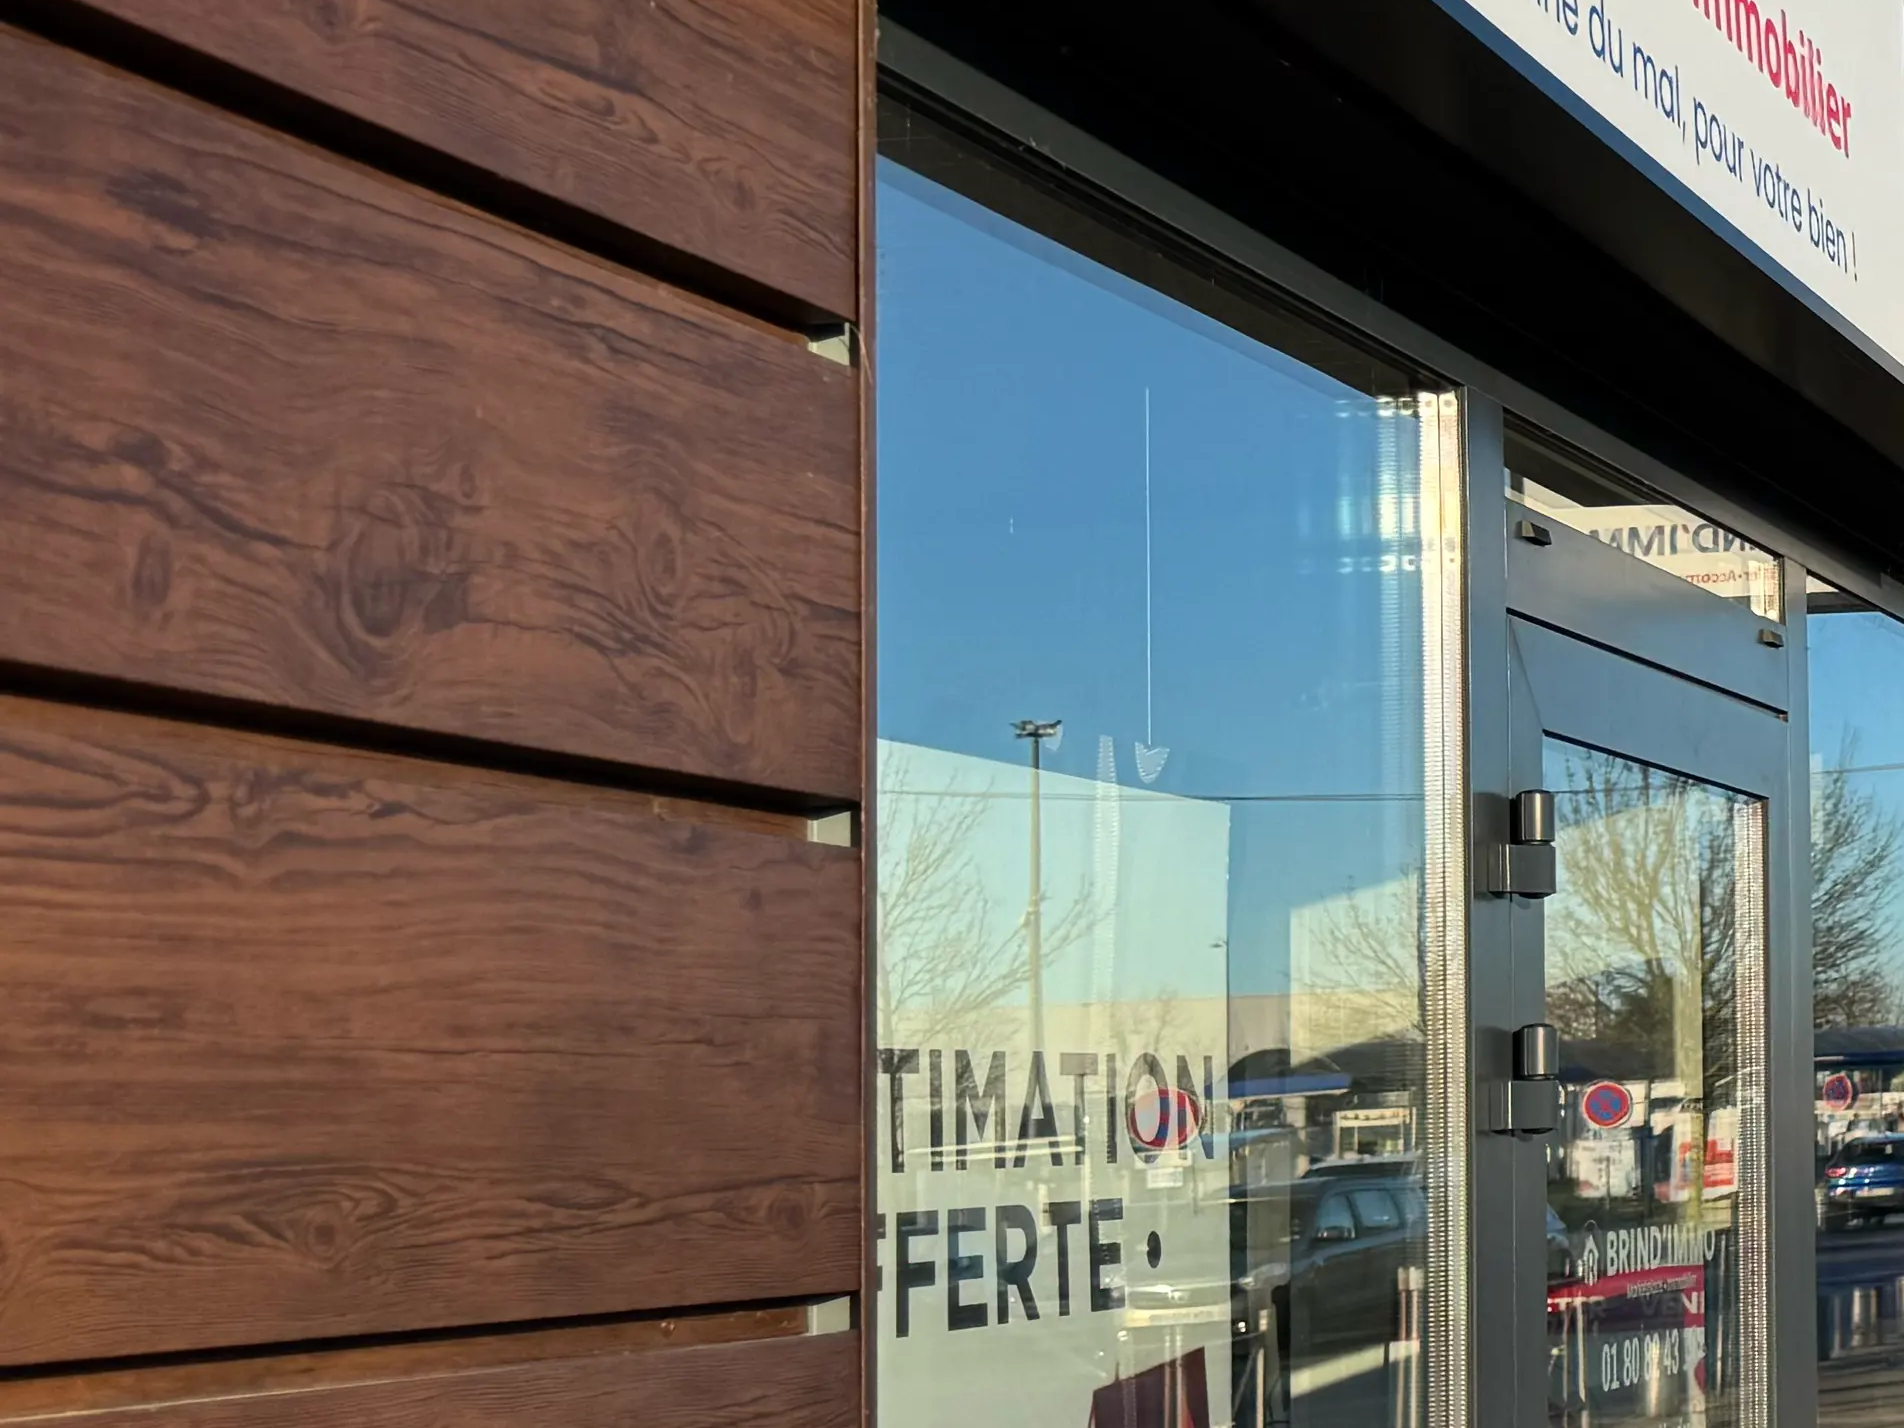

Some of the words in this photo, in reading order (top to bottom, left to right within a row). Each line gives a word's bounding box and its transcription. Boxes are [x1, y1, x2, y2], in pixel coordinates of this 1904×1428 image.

[1633, 49, 1687, 144] mal,
[1693, 96, 1744, 183] pour
[1750, 155, 1803, 234] votre
[1806, 187, 1848, 270] bien
[877, 1048, 1216, 1174] TIMATION
[877, 1197, 1127, 1339] FERTE
[1606, 1223, 1716, 1277] BRIND'IMMO
[1602, 1342, 1620, 1392] 01
[1623, 1336, 1640, 1387] 80
[1663, 1327, 1679, 1376] 43
